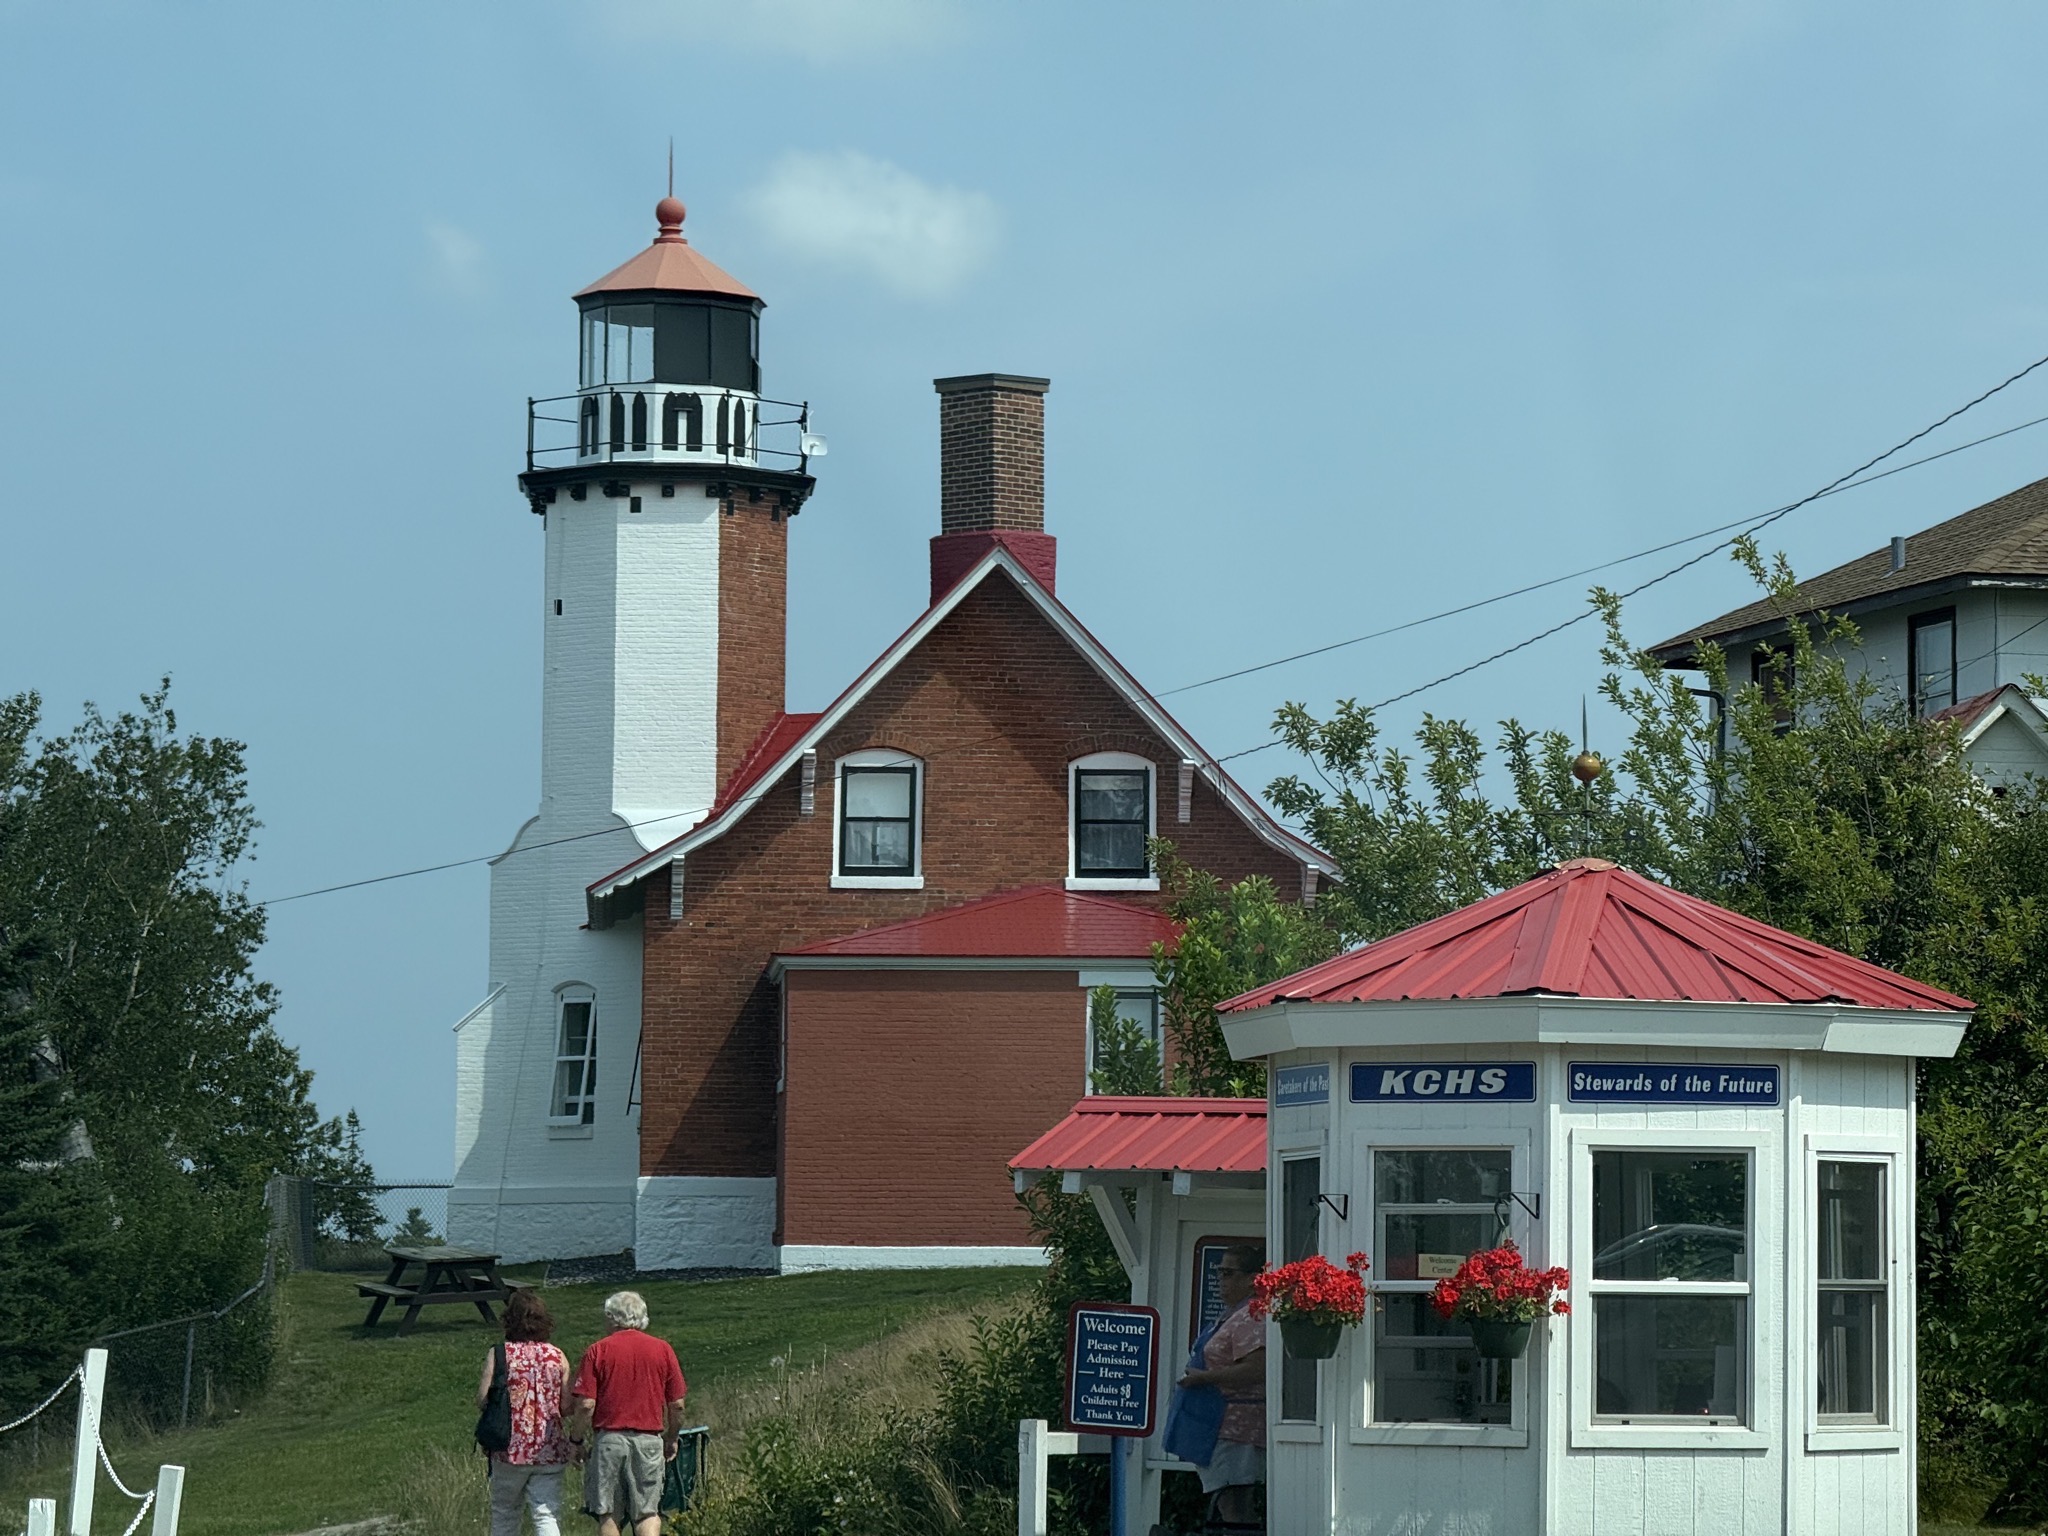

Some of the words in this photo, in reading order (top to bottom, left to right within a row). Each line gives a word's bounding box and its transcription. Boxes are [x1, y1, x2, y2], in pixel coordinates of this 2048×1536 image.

[1277, 1078, 1302, 1096] Caretakers
[1303, 1076, 1309, 1093] of
[1310, 1076, 1318, 1092] the
[1379, 1068, 1507, 1095] KCHS
[1573, 1072, 1653, 1091] Stewards
[1660, 1073, 1678, 1092] of
[1685, 1075, 1711, 1093] the
[1718, 1075, 1773, 1093] Future
[1428, 1256, 1457, 1264] Welcome
[1431, 1266, 1453, 1274] Center
[1083, 1317, 1146, 1335] Welcome
[1087, 1338, 1118, 1351] Please
[1120, 1341, 1139, 1355] Pay
[1086, 1352, 1138, 1367] Admission
[1099, 1367, 1125, 1379] Here
[1090, 1383, 1118, 1394] Adults
[1120, 1383, 1131, 1399] $8
[1081, 1394, 1118, 1406] Children
[1120, 1398, 1140, 1408] Free
[1085, 1409, 1113, 1420] Thank
[1115, 1411, 1133, 1422] You
